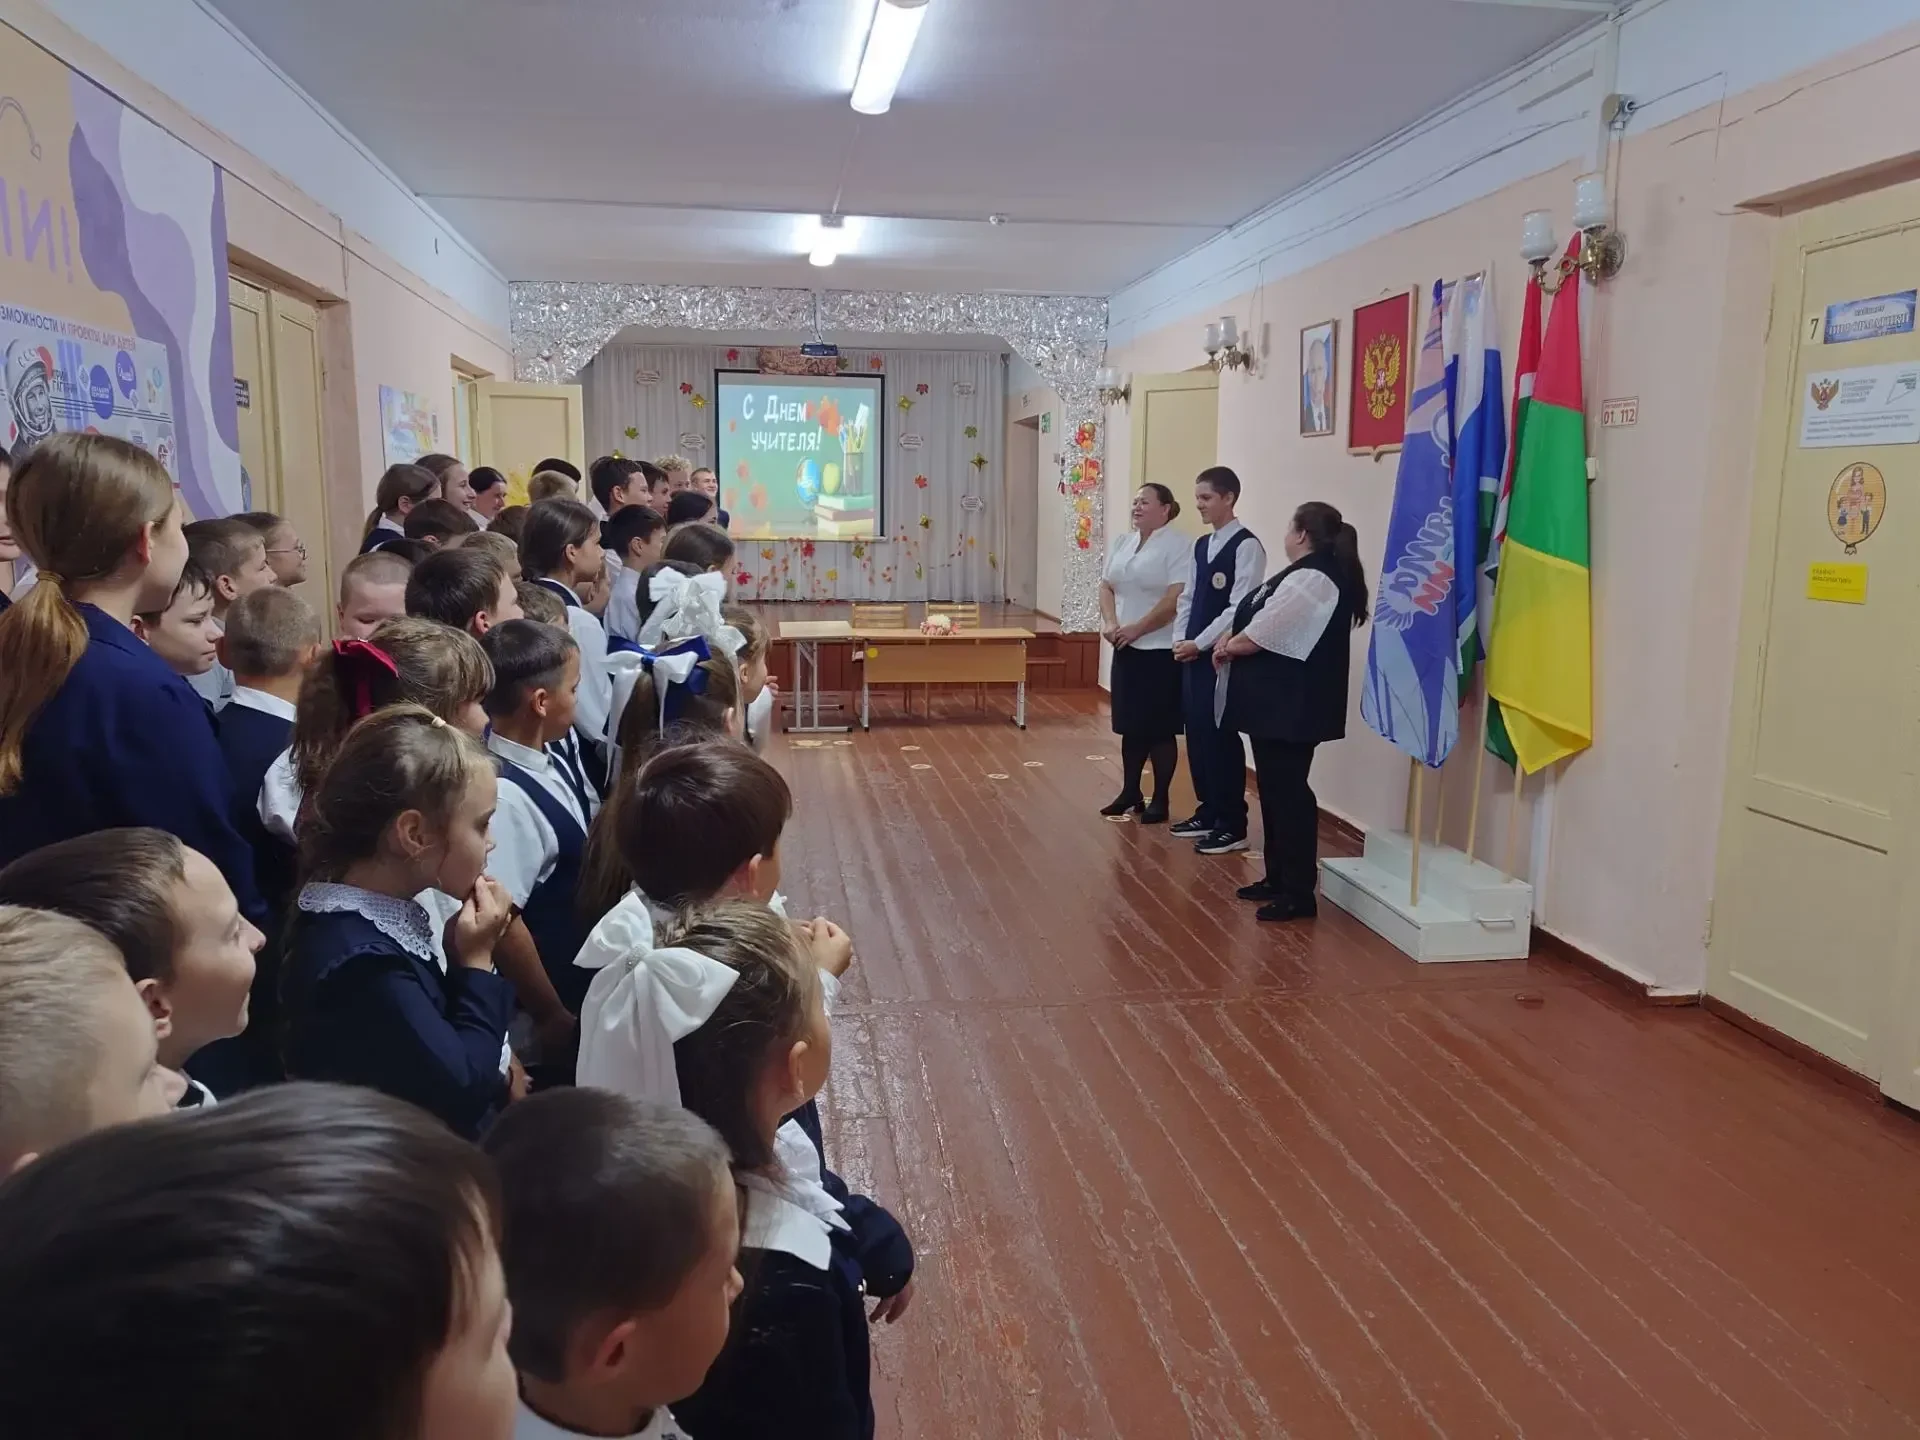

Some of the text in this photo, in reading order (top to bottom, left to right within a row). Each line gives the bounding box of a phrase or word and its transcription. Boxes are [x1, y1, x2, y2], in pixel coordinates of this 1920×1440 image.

[0, 305, 59, 333] ЗМОЖНОСТИ
[1810, 318, 1820, 340] 7
[742, 393, 755, 420] С
[1620, 408, 1635, 423] 112
[751, 425, 822, 452] УЧИТЕЛЯ!
